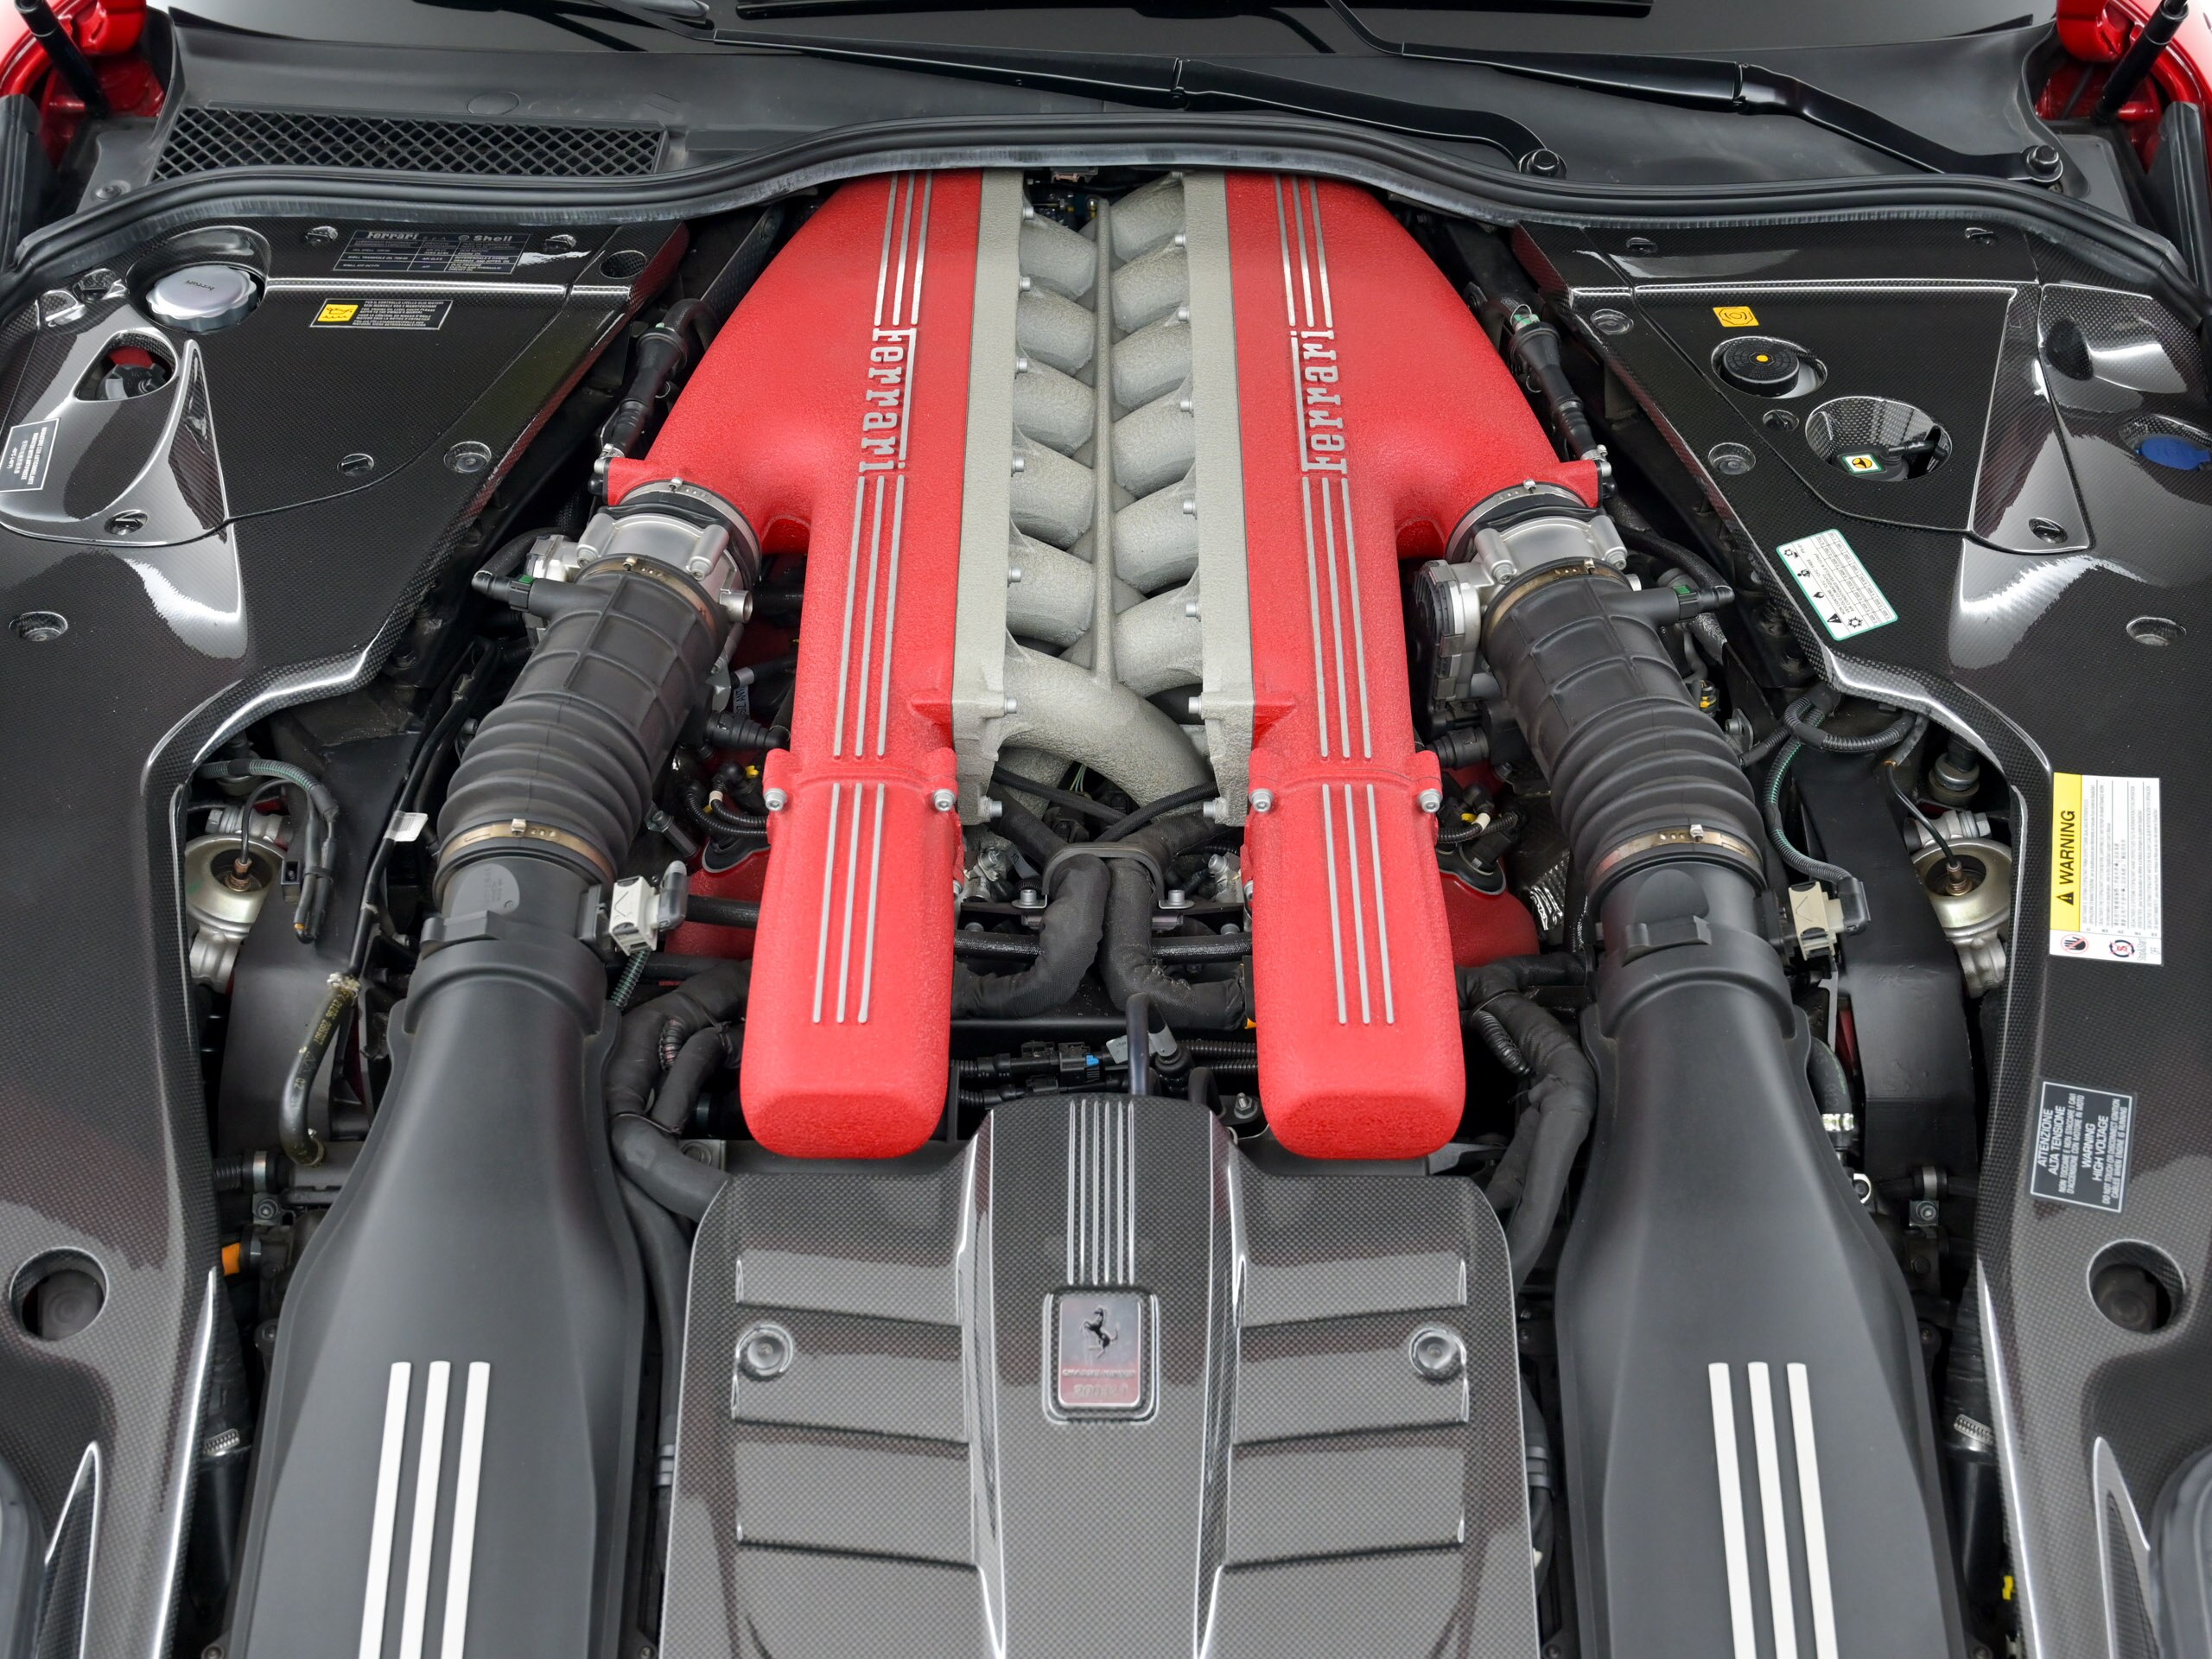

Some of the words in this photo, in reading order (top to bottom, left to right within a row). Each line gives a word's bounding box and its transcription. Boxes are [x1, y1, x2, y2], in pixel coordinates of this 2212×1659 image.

[859, 327, 917, 473] Ferrari
[1290, 330, 1348, 474] Ferrari
[2059, 810, 2075, 885] WARNING
[2075, 1094, 2085, 1110] MOTO
[2037, 1108, 2053, 1167] ATTENZIONE
[2050, 1104, 2065, 1152] TENSIONE
[2071, 1141, 2080, 1154] CON
[2072, 1118, 2082, 1141] MOTORE
[2081, 1122, 2095, 1168] WARNING
[2094, 1115, 2108, 1155] VOLTAGE
[2048, 1152, 2060, 1175] ALTA
[2092, 1156, 2104, 1181] HIGH
[2058, 1179, 2067, 1193] NON
